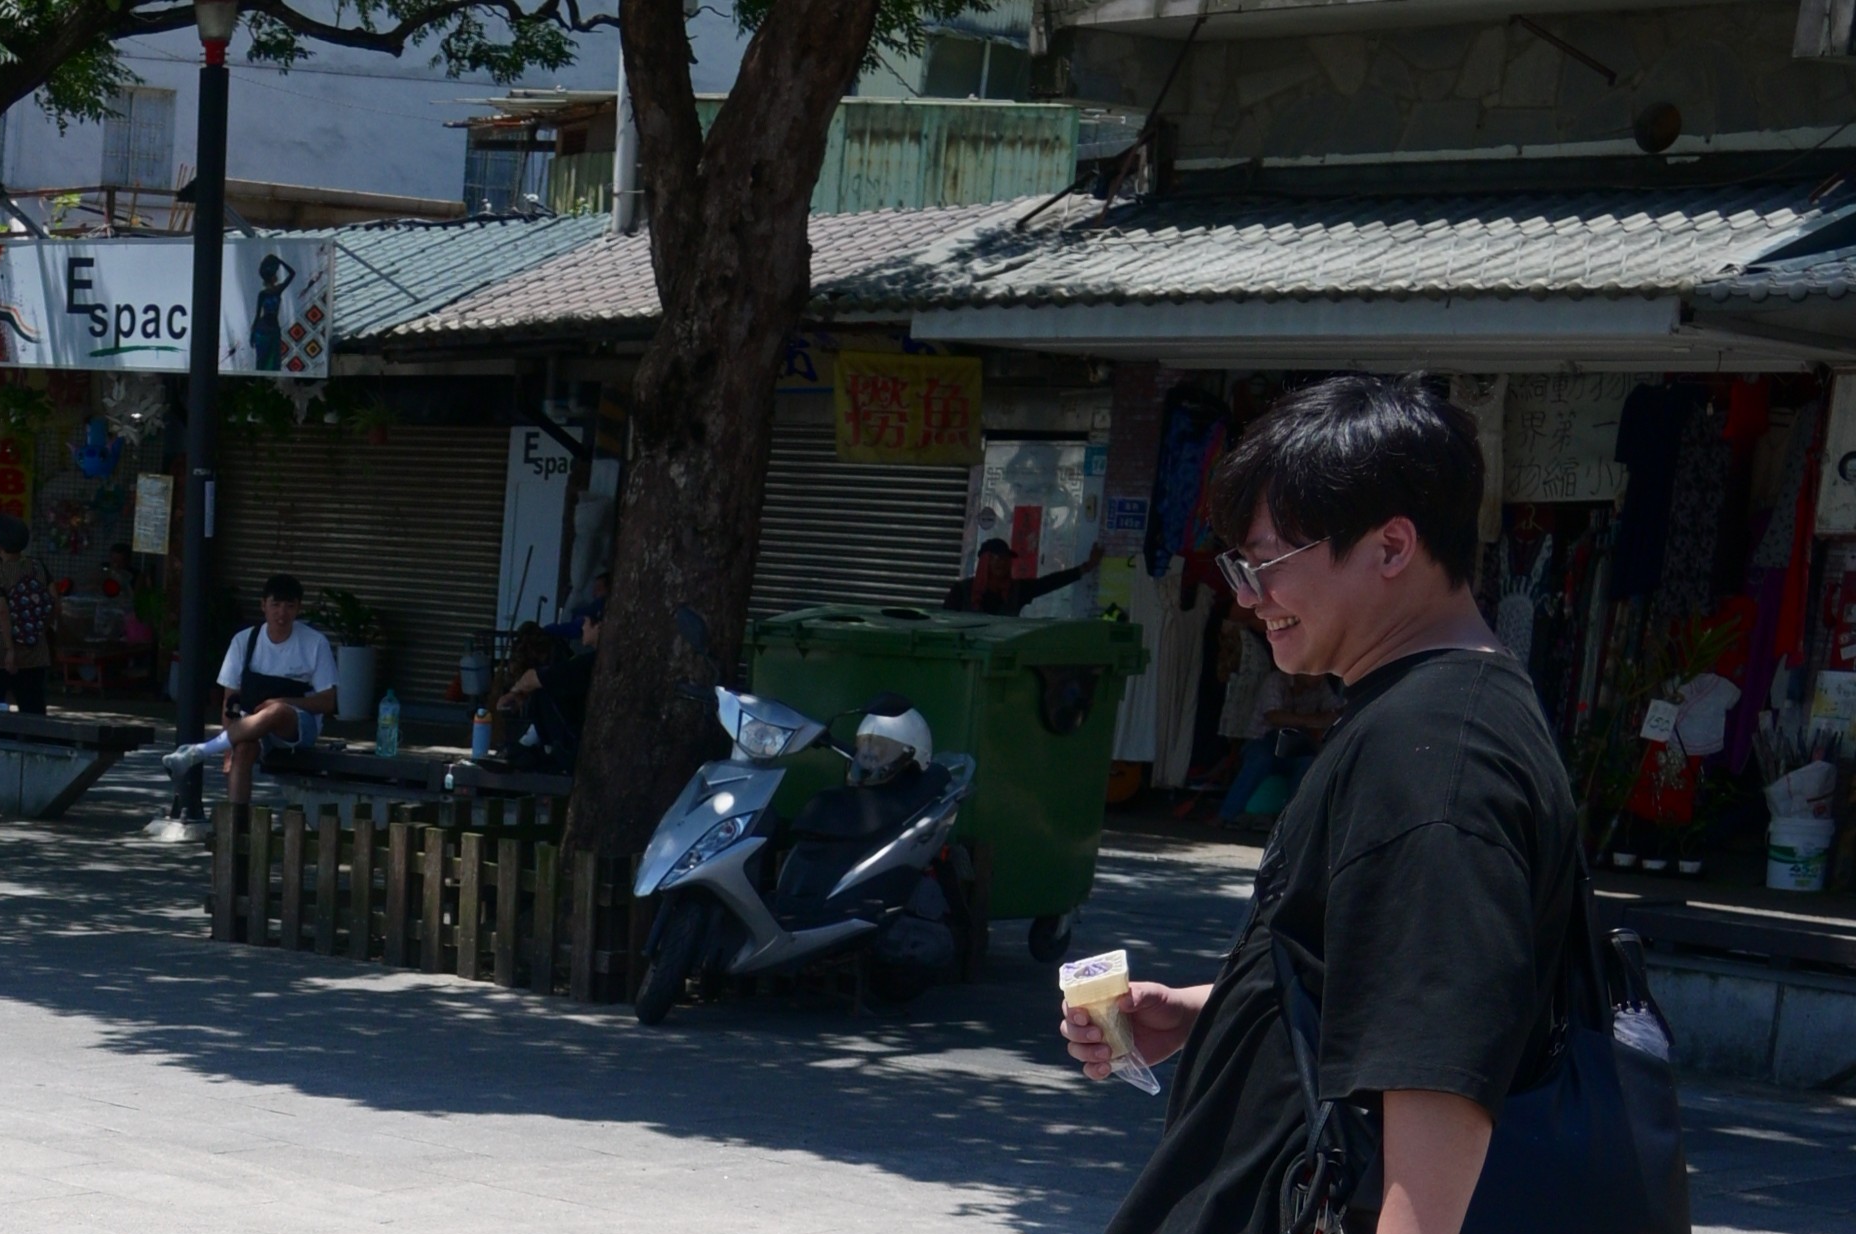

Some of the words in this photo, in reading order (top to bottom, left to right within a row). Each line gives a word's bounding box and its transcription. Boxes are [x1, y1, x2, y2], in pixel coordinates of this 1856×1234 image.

[845, 373, 971, 449] 撈魚
[1504, 403, 1619, 453] 界第一
